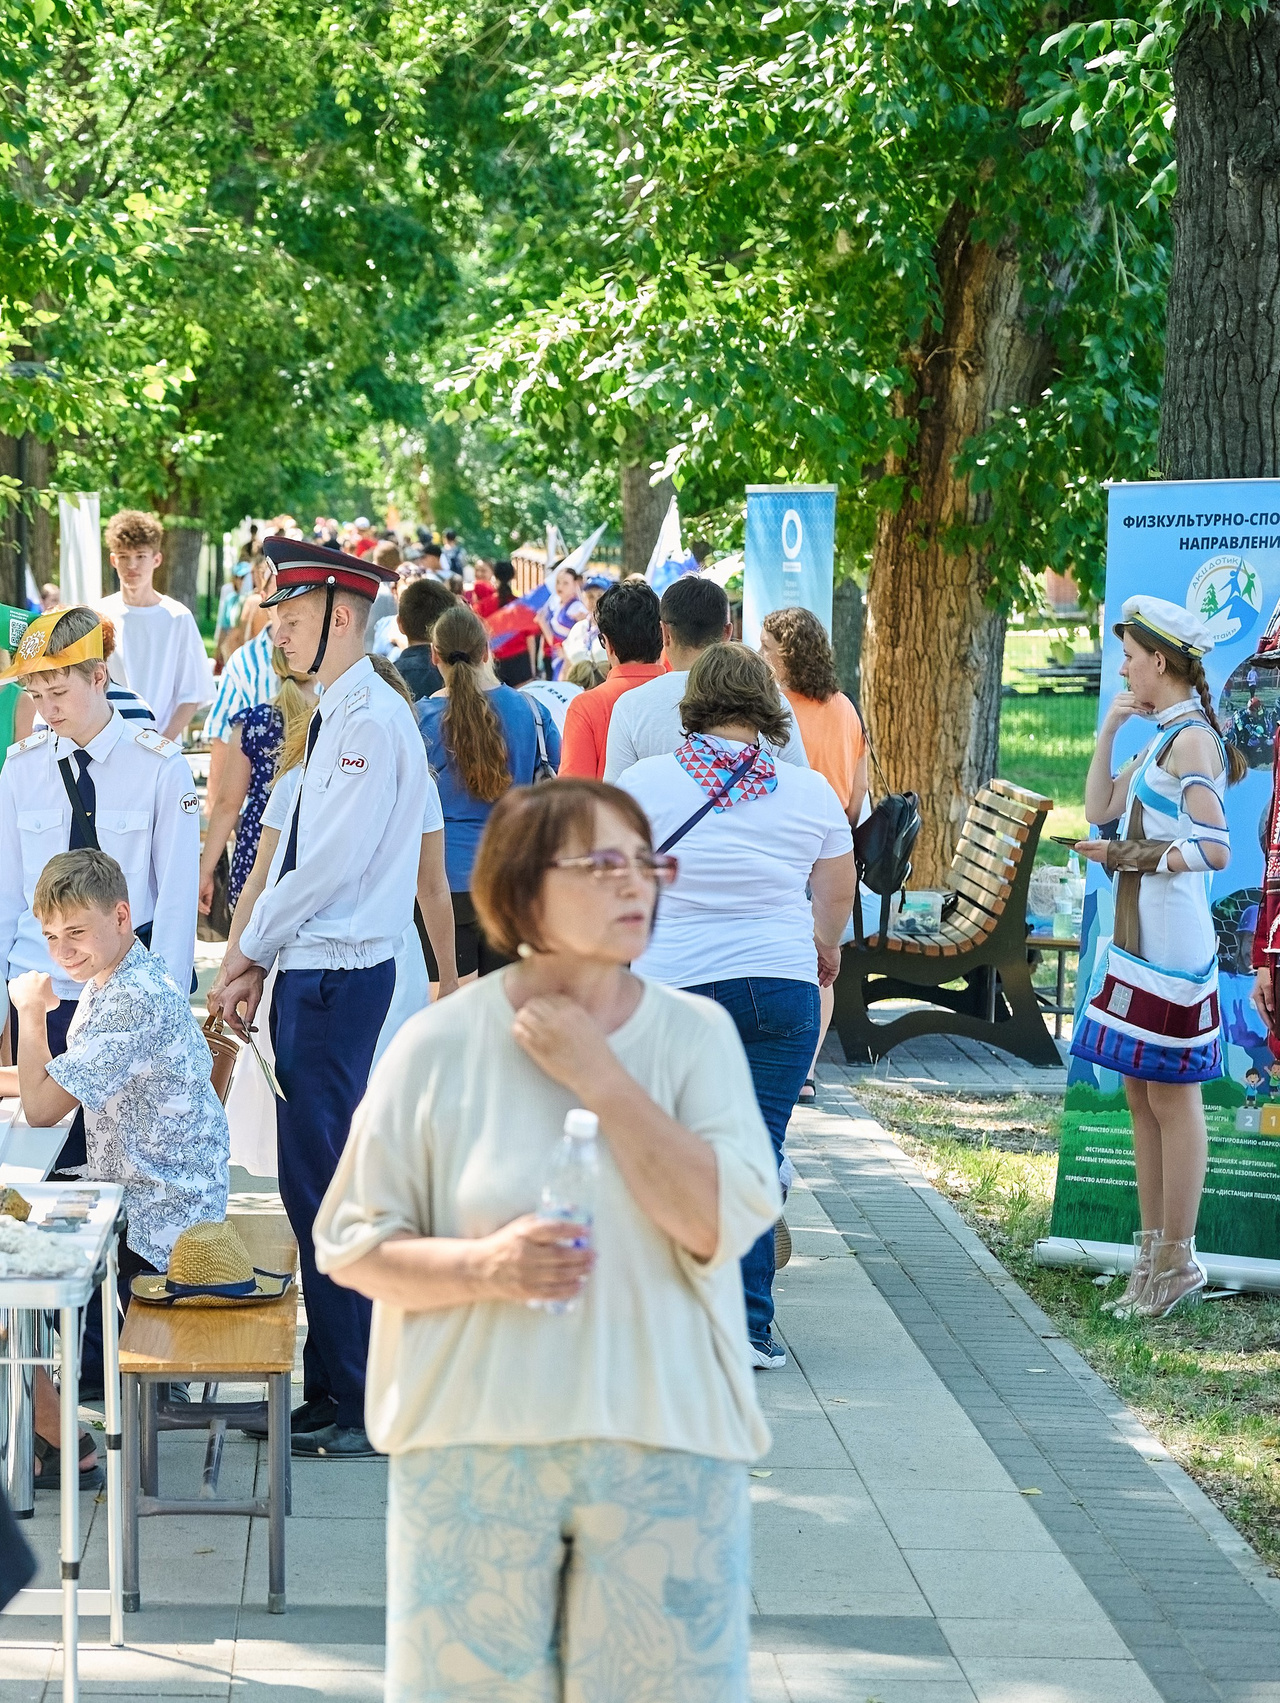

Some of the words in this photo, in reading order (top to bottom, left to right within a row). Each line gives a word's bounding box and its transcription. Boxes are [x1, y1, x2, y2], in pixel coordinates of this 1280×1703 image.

[1123, 512, 1280, 529] ФИЗКУЛЬТУРНО-СПО
[1179, 535, 1280, 550] НАПРАВЛЕНИ
[1245, 1115, 1253, 1127] 2
[1270, 1115, 1277, 1127] 1
[1079, 1125, 1110, 1133] ПЕРВЕНСТВО
[1075, 1155, 1098, 1163] КРАЕВЫЕ
[1085, 1146, 1115, 1154] ФЕСТИВАЛЬ
[1207, 1156, 1238, 1165] МЕЩЕНИЯХ
[1065, 1175, 1096, 1183] ПЕРВЕНСТВО
[1095, 1178, 1129, 1186] АЛТАЙСКОГО
[1216, 1188, 1254, 1199] «ДИСТАНЦИЯ
